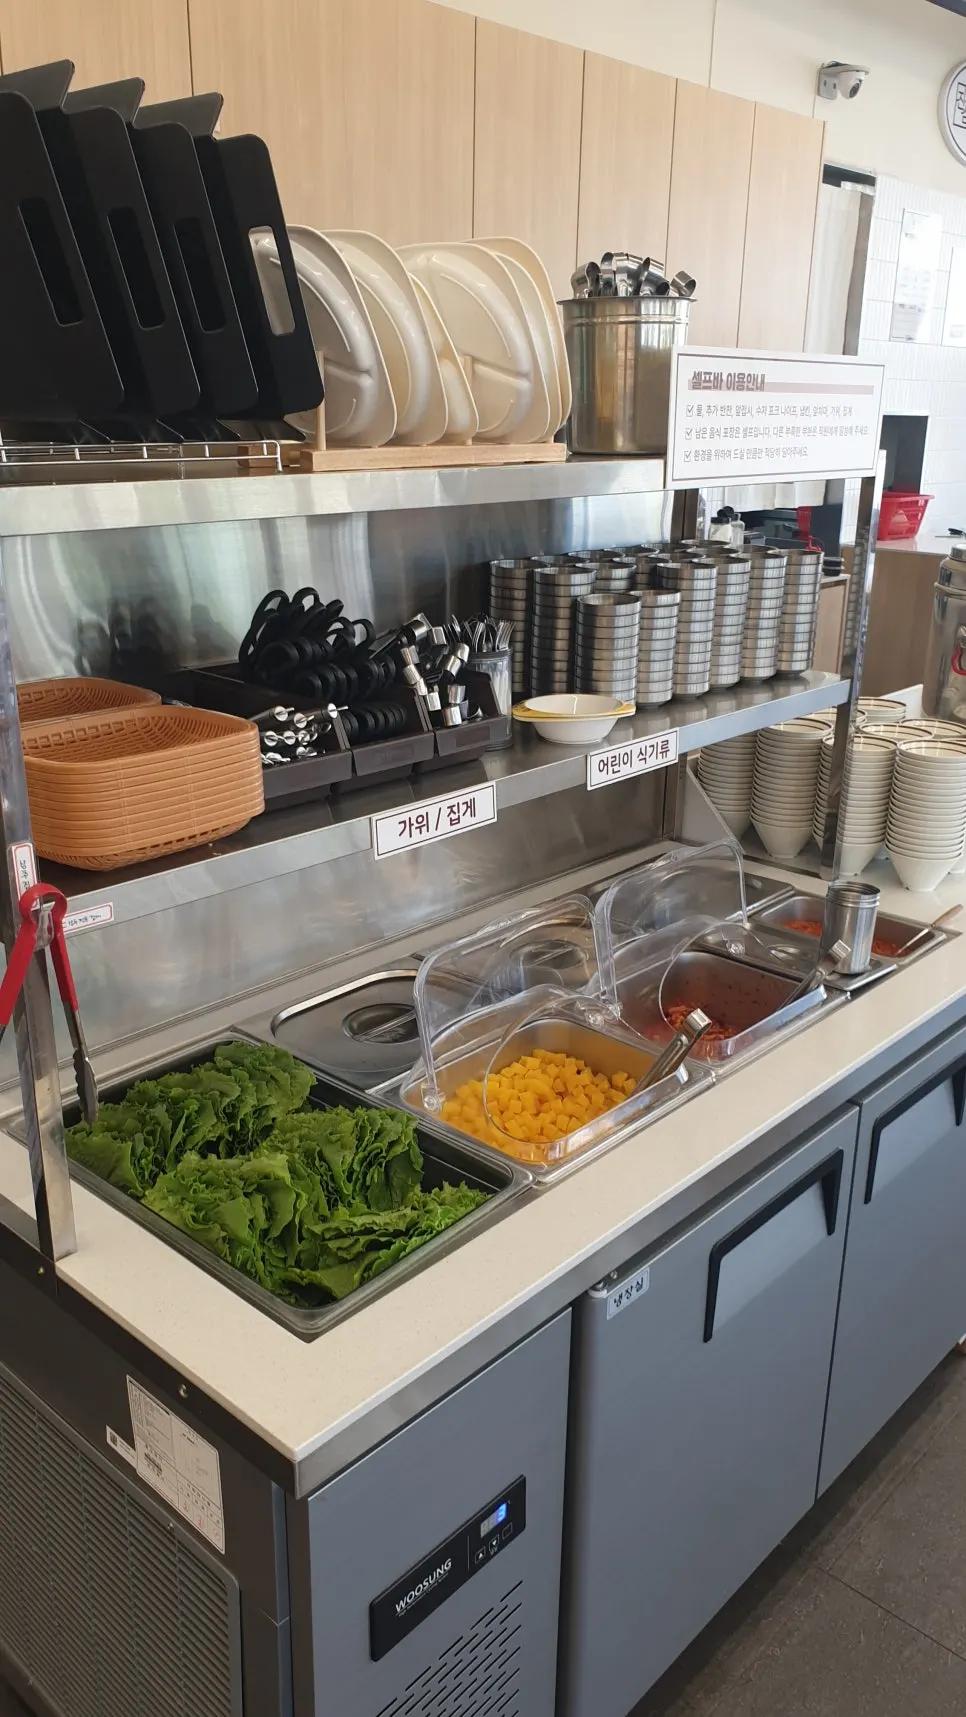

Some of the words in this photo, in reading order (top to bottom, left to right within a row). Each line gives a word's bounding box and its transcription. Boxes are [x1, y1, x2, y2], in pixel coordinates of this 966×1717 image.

[692, 371, 723, 391] 셀프바
[726, 372, 765, 392] 이용안내
[705, 404, 719, 417] 추가
[719, 404, 734, 418] 반찬,
[735, 404, 754, 419] 앞접시,
[695, 426, 708, 440] 남은
[709, 426, 721, 440] 음식
[722, 426, 741, 439] 포장은
[742, 426, 772, 439] 셀프입니다.
[773, 425, 784, 438] 다른
[694, 448, 713, 462] 환경을
[713, 448, 732, 461] 위하여
[732, 448, 745, 460] 드실
[746, 447, 764, 460] 만큼만
[764, 447, 781, 459] 적당히
[598, 750, 633, 775] 어린이
[637, 739, 670, 765] 식기류
[398, 810, 430, 839] 가위
[446, 797, 477, 827] 집게
[613, 1276, 644, 1308] 냉장실
[395, 1558, 452, 1612] WOOSUNG
